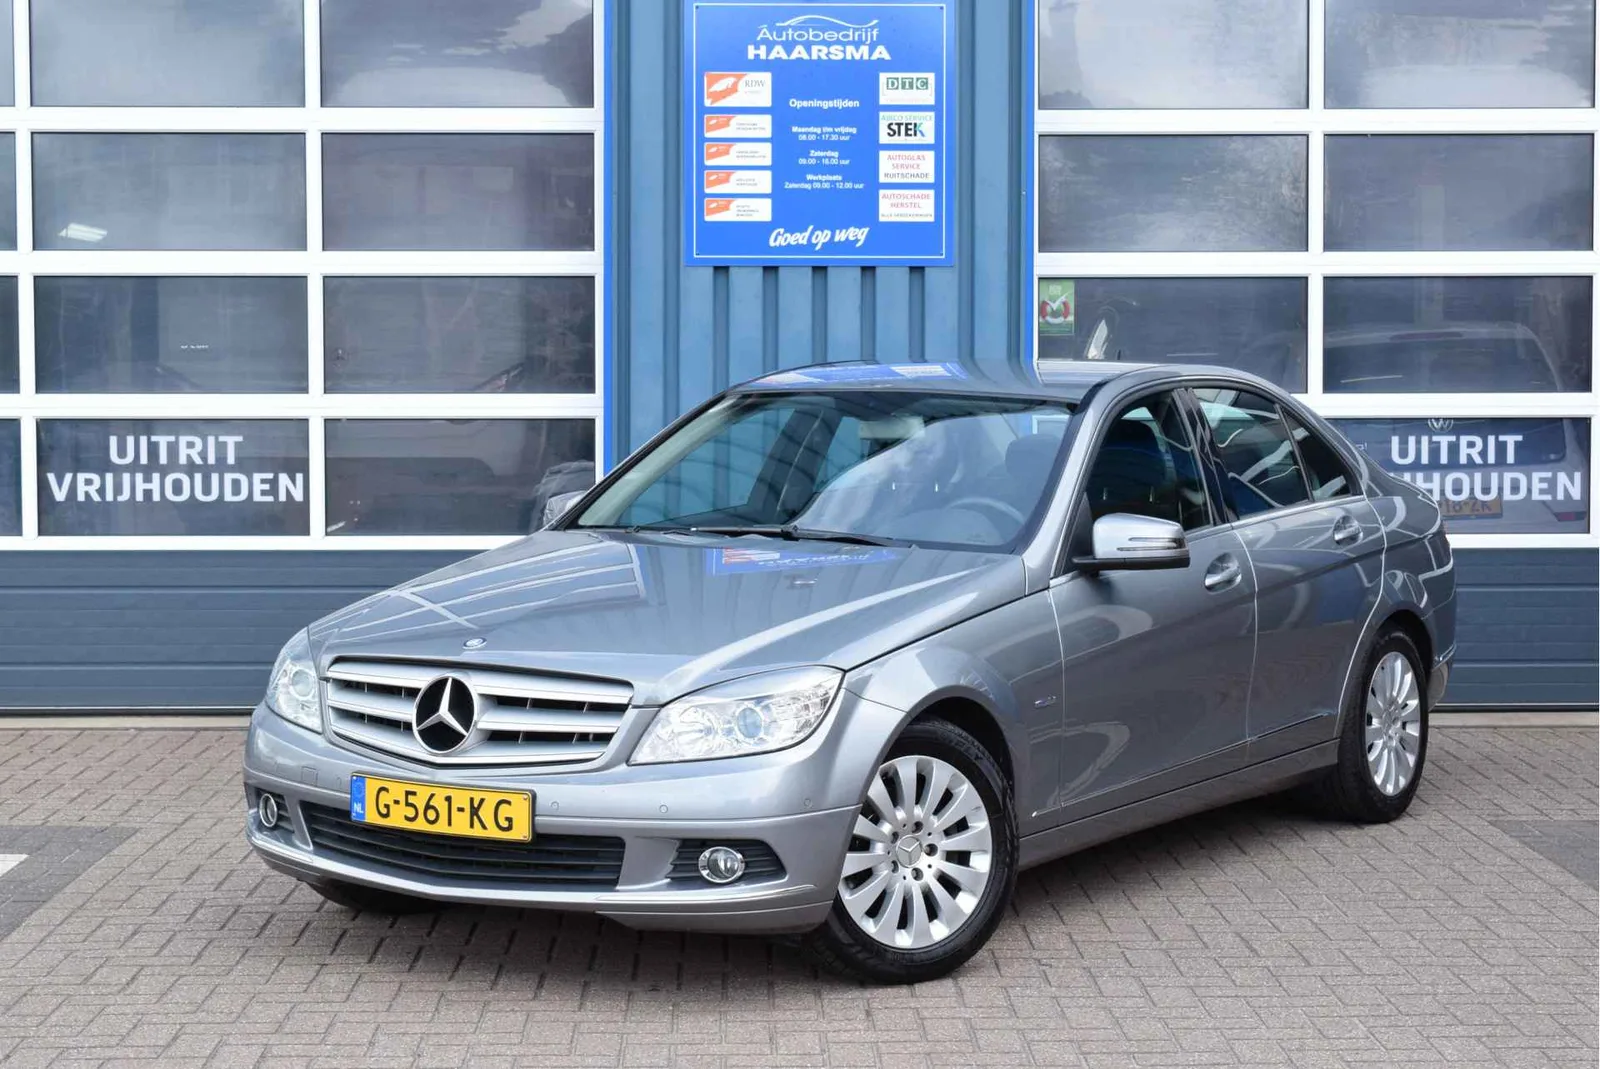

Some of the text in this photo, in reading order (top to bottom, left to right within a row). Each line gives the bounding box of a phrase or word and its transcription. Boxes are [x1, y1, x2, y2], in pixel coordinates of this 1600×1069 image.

[756, 25, 879, 44] Autobedrijf
[747, 45, 891, 60] HAARSMA
[744, 79, 766, 88] RDW
[886, 77, 929, 90] DTC
[789, 98, 860, 109] Openingstijden
[887, 122, 926, 137] STEK
[809, 150, 839, 158] Zaterdag
[784, 182, 812, 190] Zaterdag
[768, 225, 870, 251] Goed op weg
[109, 435, 243, 465] UITRIT
[1391, 435, 1523, 465] UITRIT
[47, 472, 304, 502] VRIJHOUDEN
[1388, 472, 1581, 501] HOUDEN
[353, 803, 364, 813] NL
[375, 786, 514, 832] G-561-KG
